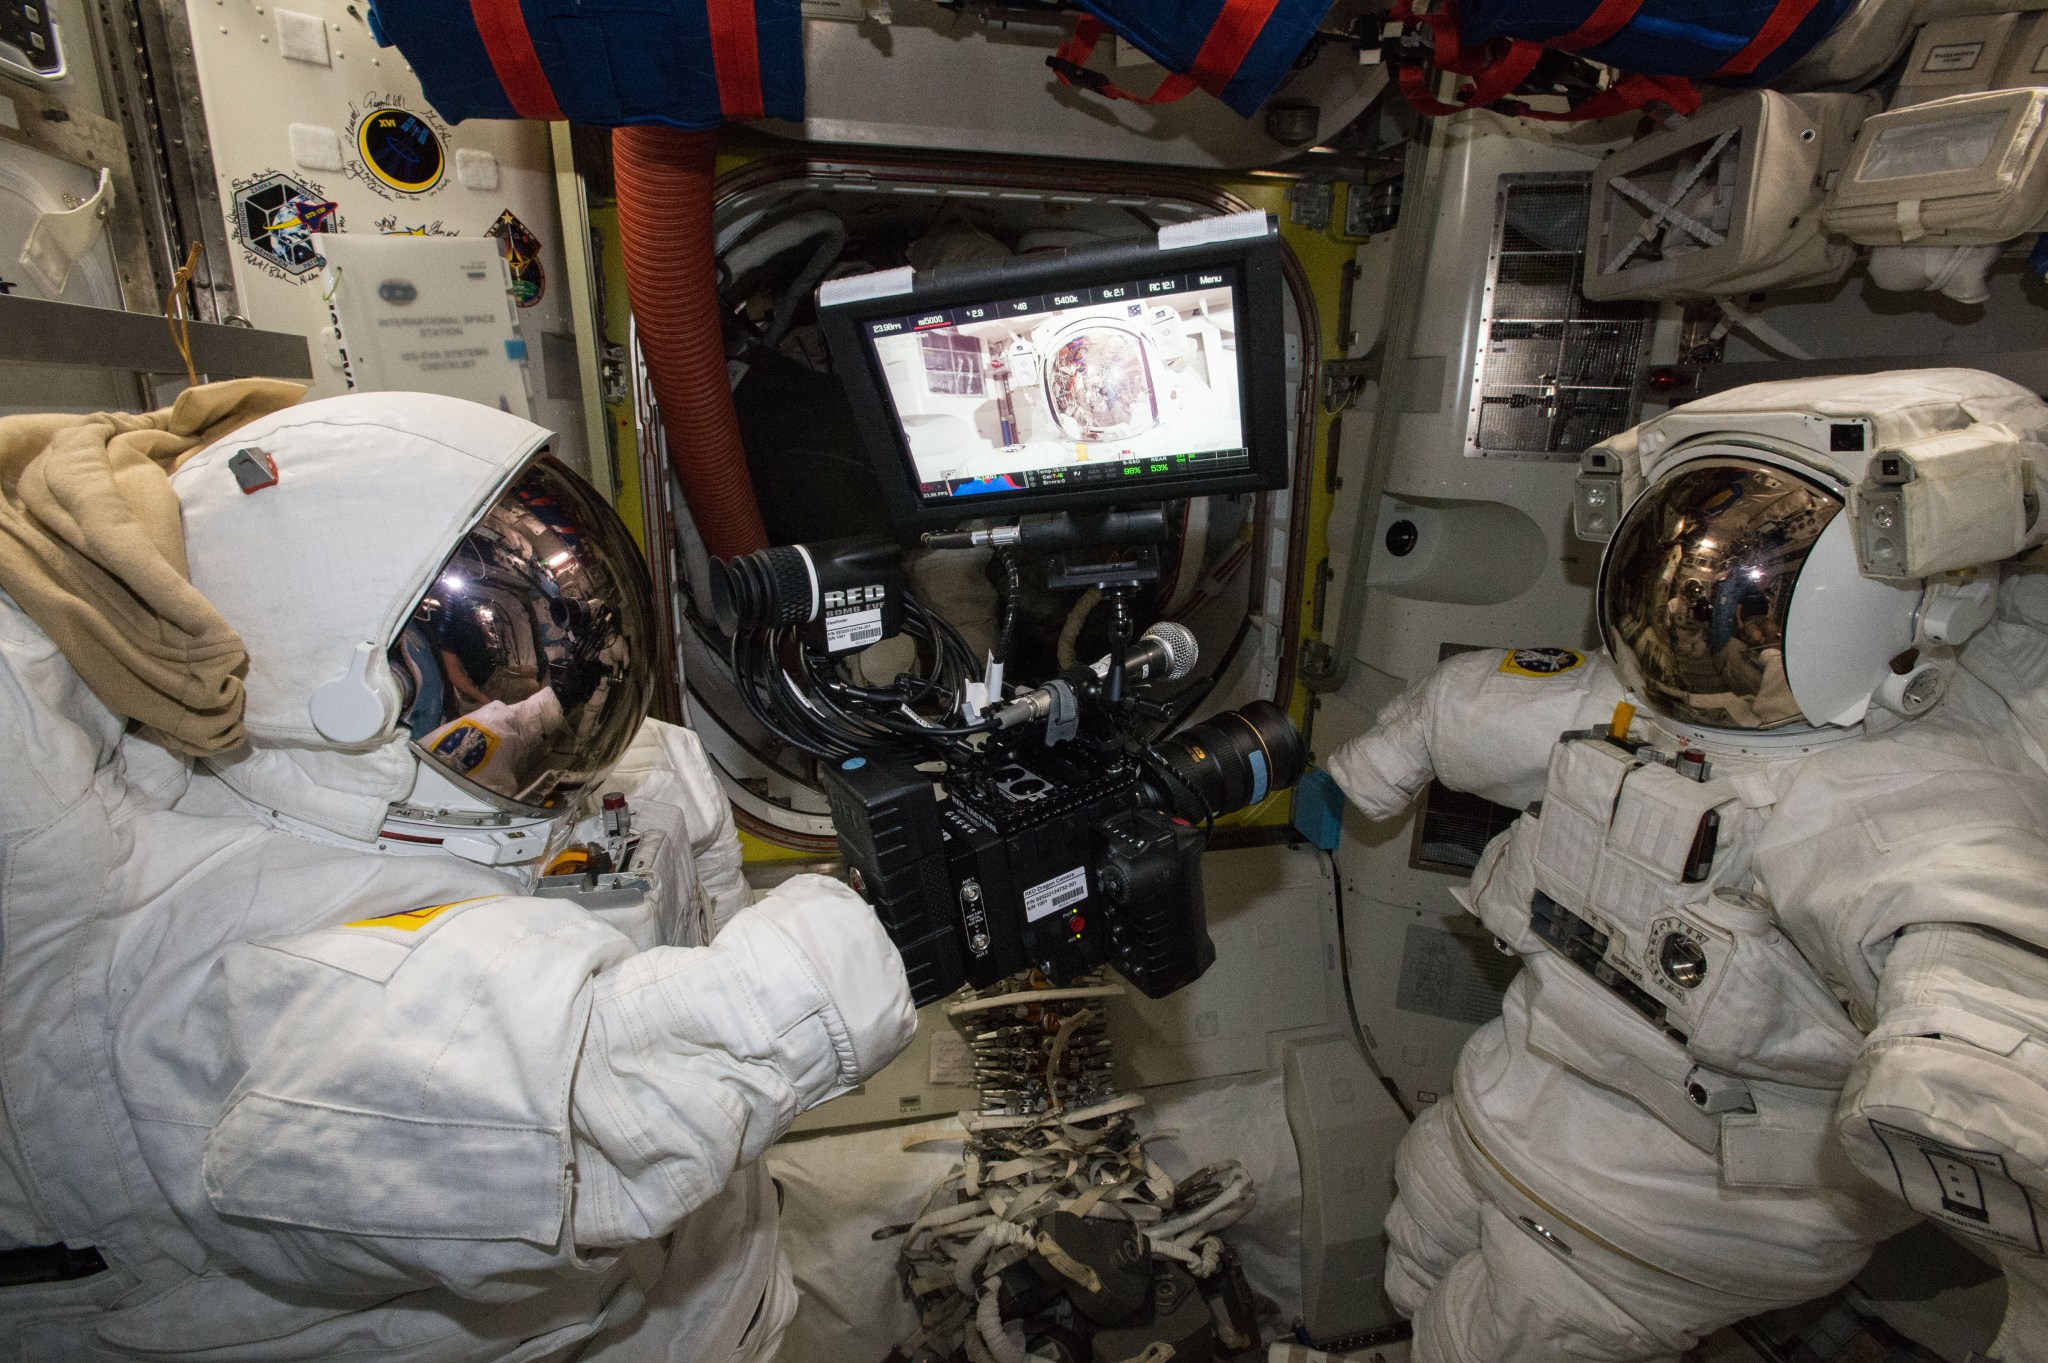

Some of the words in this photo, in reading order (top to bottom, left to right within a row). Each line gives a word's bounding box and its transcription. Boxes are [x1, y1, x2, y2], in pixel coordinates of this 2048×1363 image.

[378, 119, 397, 128] XVI
[249, 182, 274, 194] ZAMKA
[295, 186, 315, 201] VIRTS
[239, 202, 249, 238] ROBINSON
[304, 207, 326, 220] STS-130
[254, 247, 288, 268] BEHNKEN
[1149, 282, 1160, 292] RC
[1161, 280, 1175, 290] 12:1
[1199, 274, 1222, 285] Menu
[1114, 287, 1125, 297] 2:1
[378, 316, 459, 328] INTERNATIONAL
[462, 314, 497, 324] SPACE
[419, 327, 463, 338] STATION
[1123, 467, 1142, 475] 98%
[1150, 464, 1169, 473] 53%
[824, 584, 886, 609] RED
[826, 605, 861, 618] BOMB
[965, 805, 998, 834] TACTICAL
[1024, 889, 1036, 897] RED
[1037, 880, 1055, 892] Dragon
[1055, 872, 1075, 884] Camera
[1027, 904, 1036, 912] S/N
[1036, 899, 1048, 907] 1001
